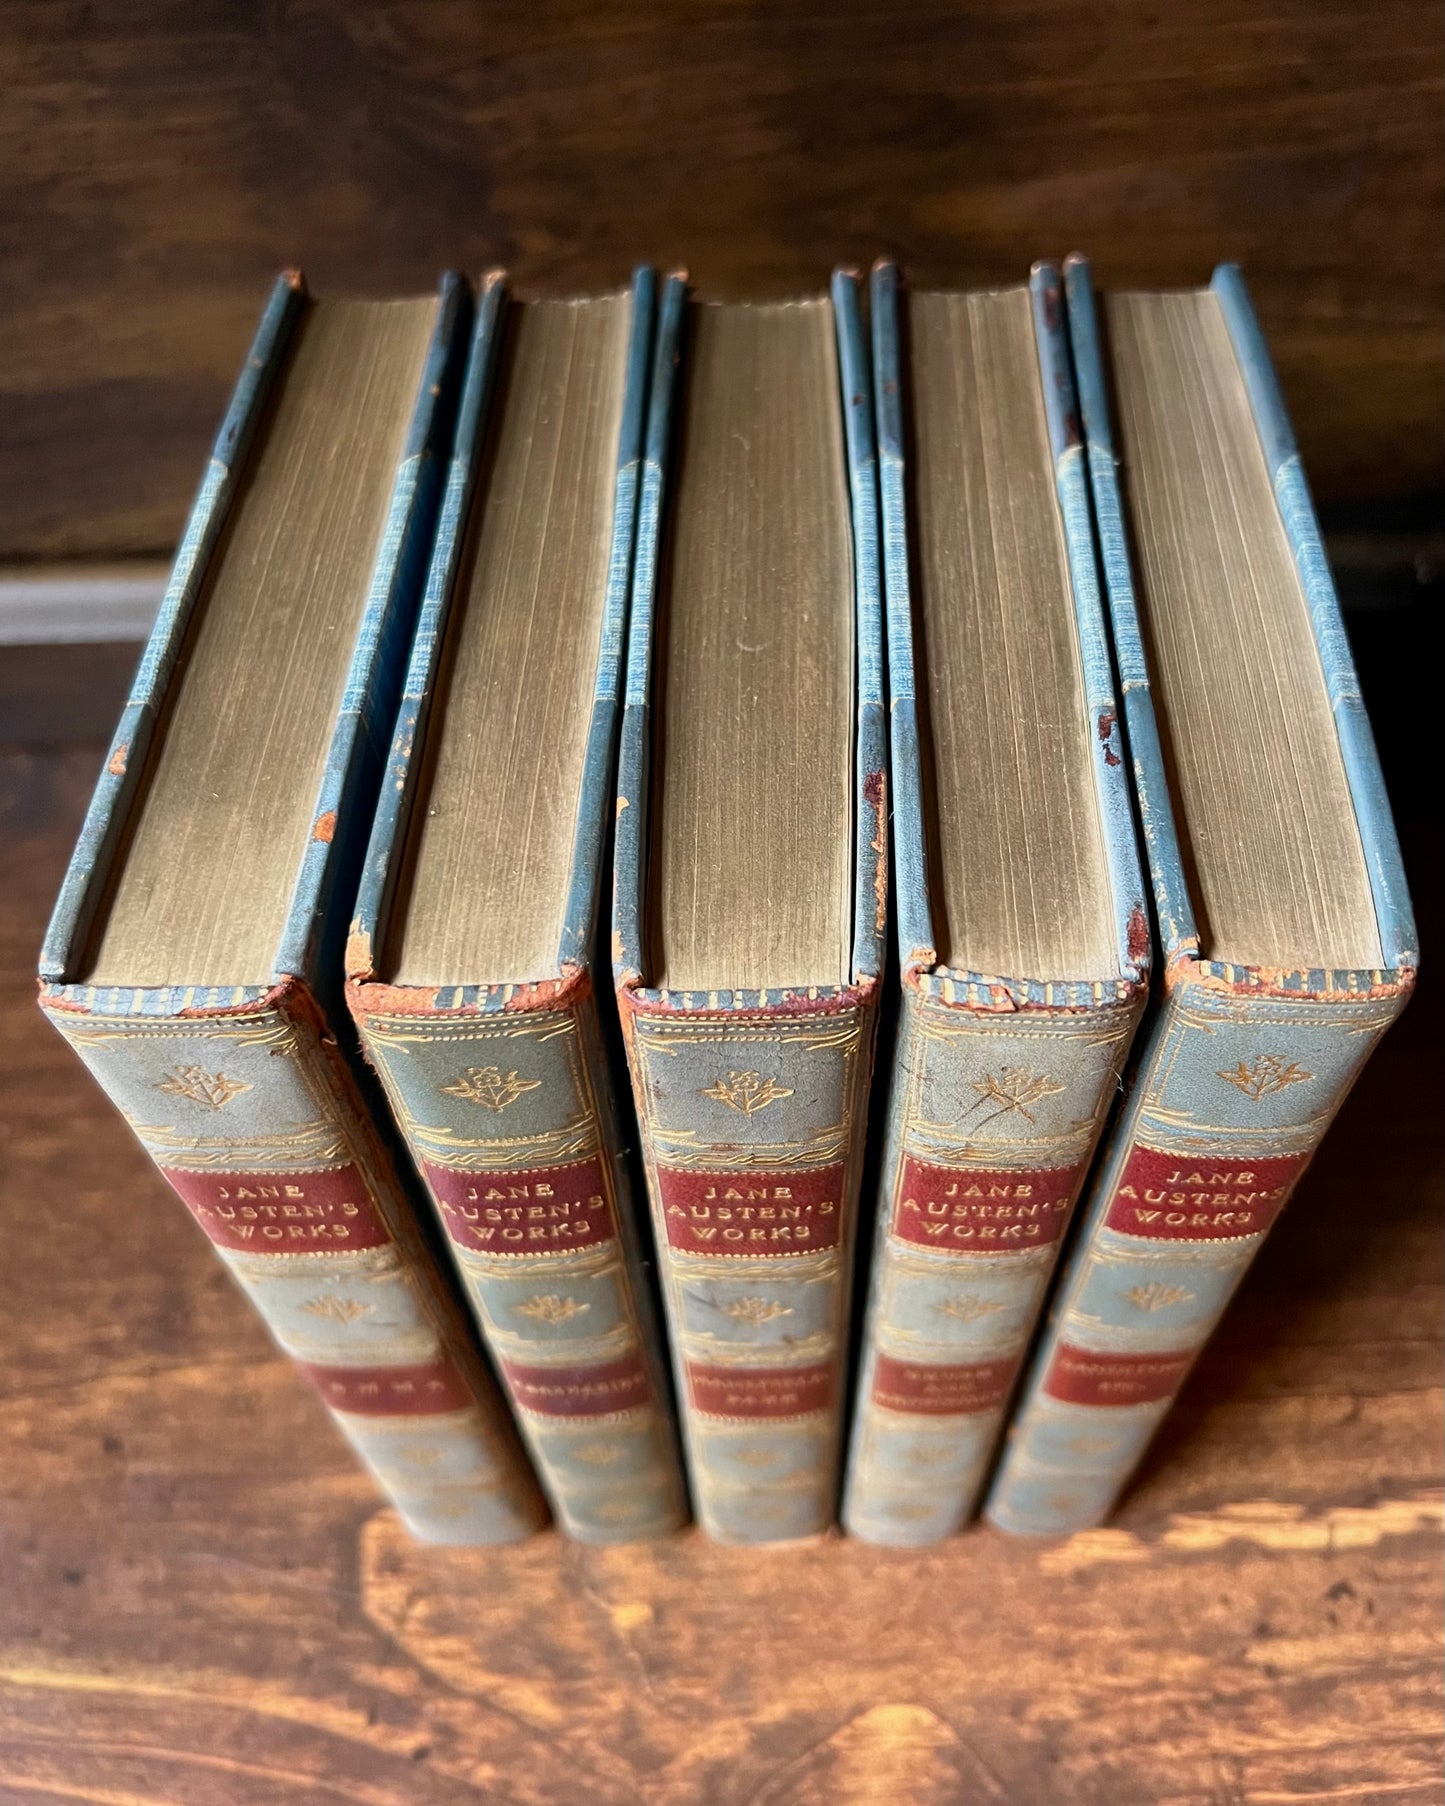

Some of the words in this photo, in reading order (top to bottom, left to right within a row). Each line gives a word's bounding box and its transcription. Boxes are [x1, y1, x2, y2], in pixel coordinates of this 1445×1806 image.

[1165, 1170, 1258, 1185] JANE
[218, 1185, 305, 1199] JANE
[467, 1183, 555, 1200] JANE
[704, 1186, 793, 1200] JANE
[944, 1183, 1033, 1198] JANE
[439, 1194, 605, 1221] AUSTEN'S
[665, 1200, 835, 1220] AUSTEN'S
[902, 1197, 1069, 1219] AUSTEN'S
[1132, 1207, 1253, 1226] WORKS
[227, 1223, 351, 1240] WORKS
[466, 1219, 591, 1241] WORKS
[689, 1225, 811, 1241] WORKS
[919, 1220, 1041, 1239] WORKS
